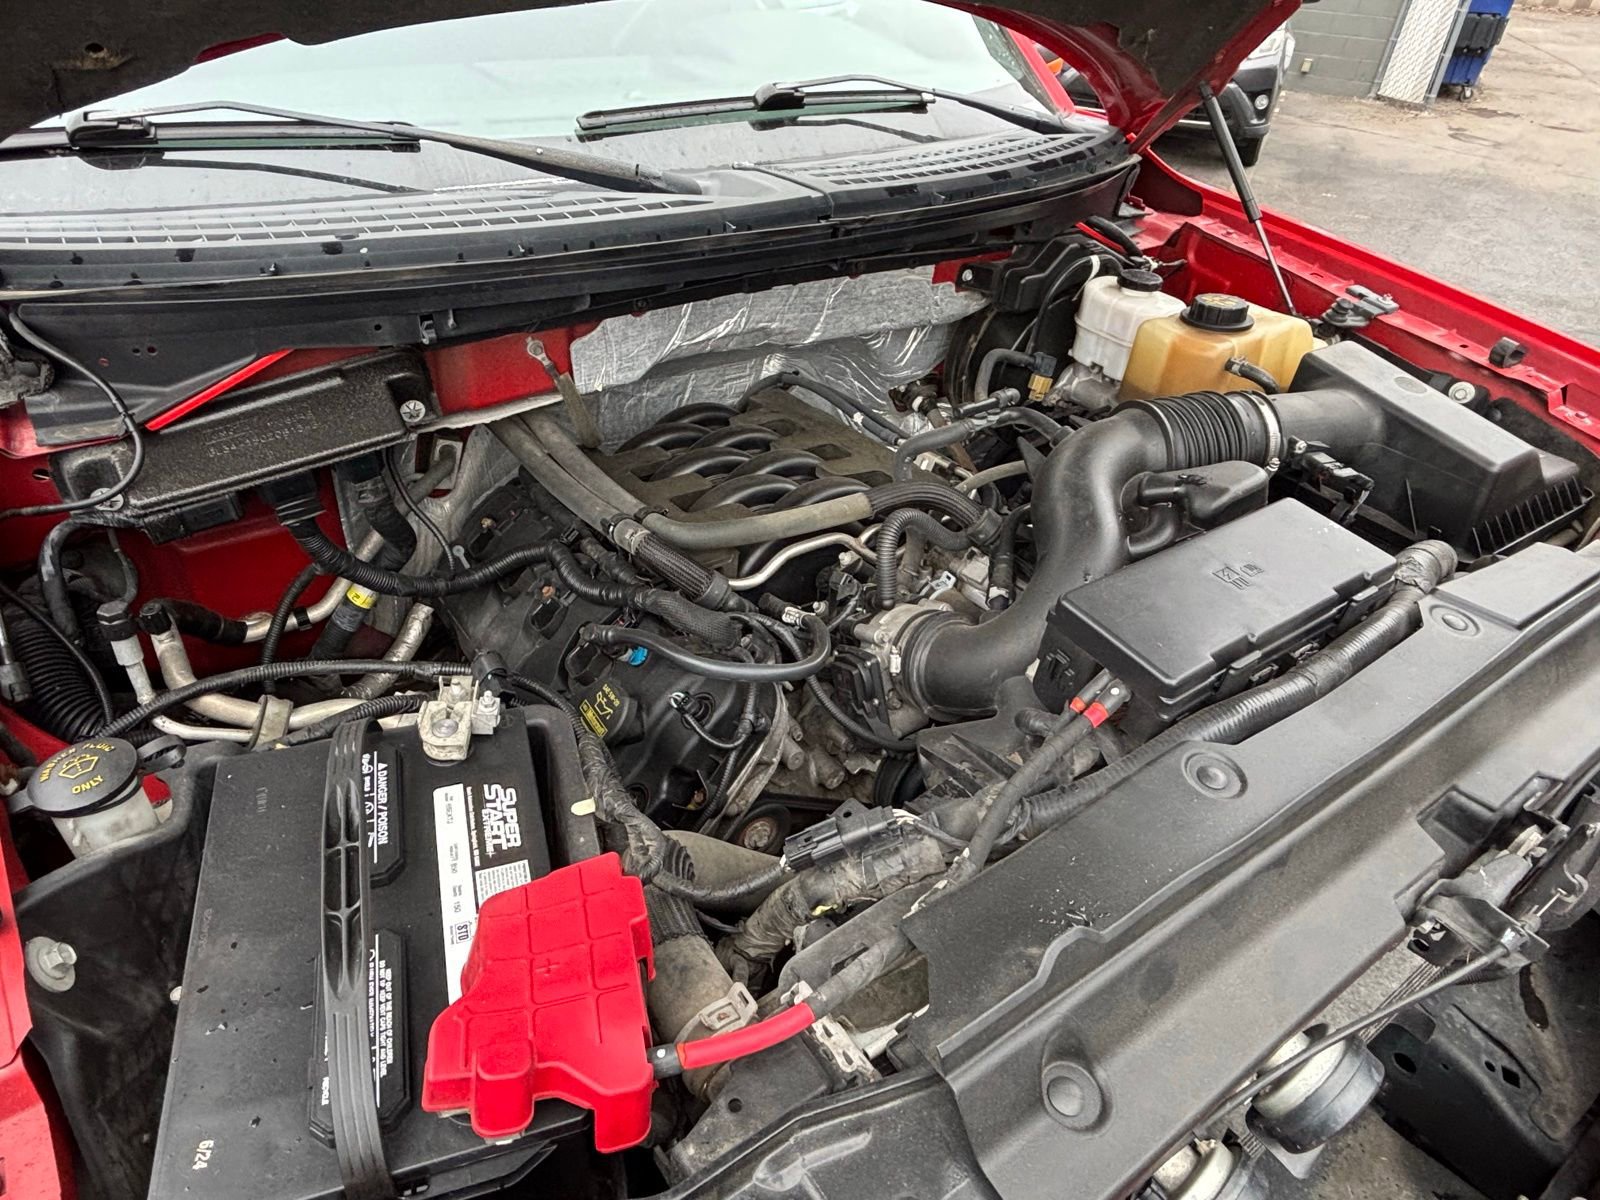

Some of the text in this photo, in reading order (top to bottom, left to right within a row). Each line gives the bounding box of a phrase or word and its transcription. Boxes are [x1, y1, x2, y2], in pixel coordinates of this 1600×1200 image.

[39, 742, 115, 782] WASHER FLUID
[71, 774, 104, 794] ONLY
[377, 770, 388, 803] DANGER
[377, 811, 388, 845] POISON
[483, 784, 508, 850] START
[501, 787, 522, 848] SUPER
[192, 1139, 215, 1170] 6/24
